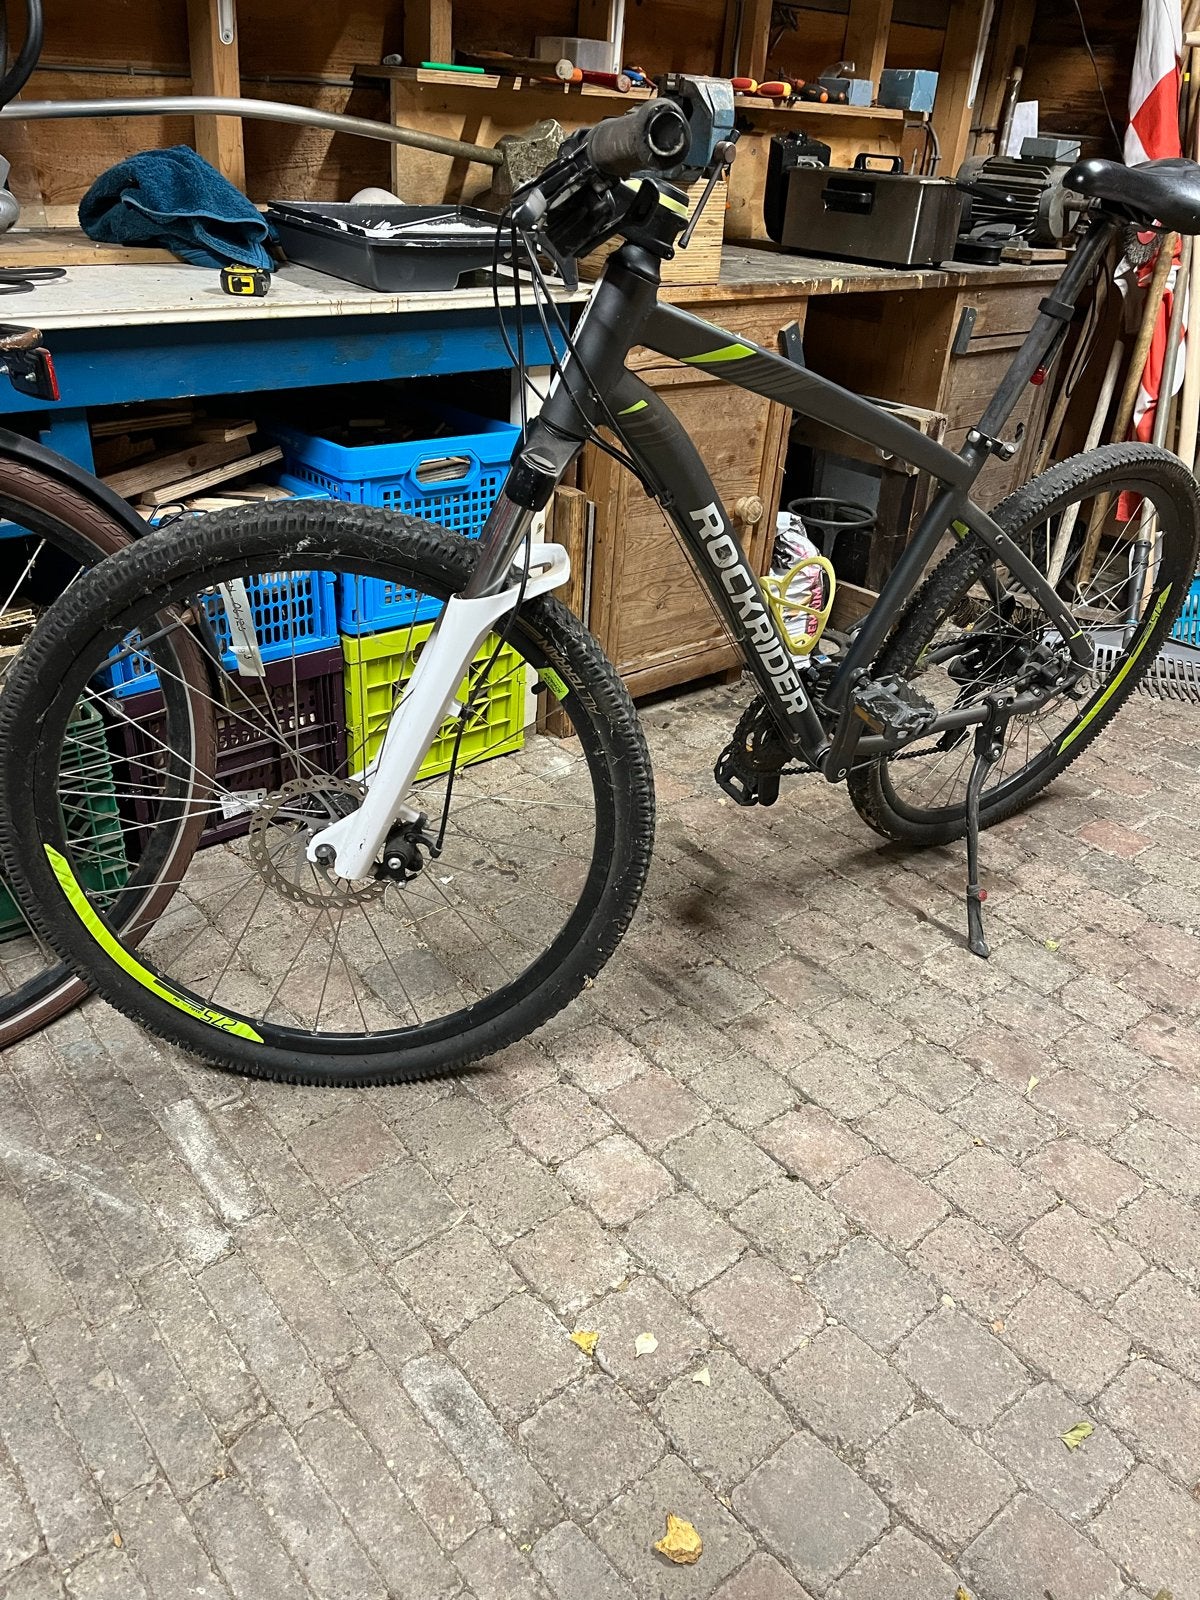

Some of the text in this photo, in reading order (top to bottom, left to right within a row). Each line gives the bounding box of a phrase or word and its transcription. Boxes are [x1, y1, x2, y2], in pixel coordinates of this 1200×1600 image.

[689, 502, 808, 715] ROCKRIDER
[538, 639, 586, 692] TERRAIN
[581, 692, 602, 715] ALL
